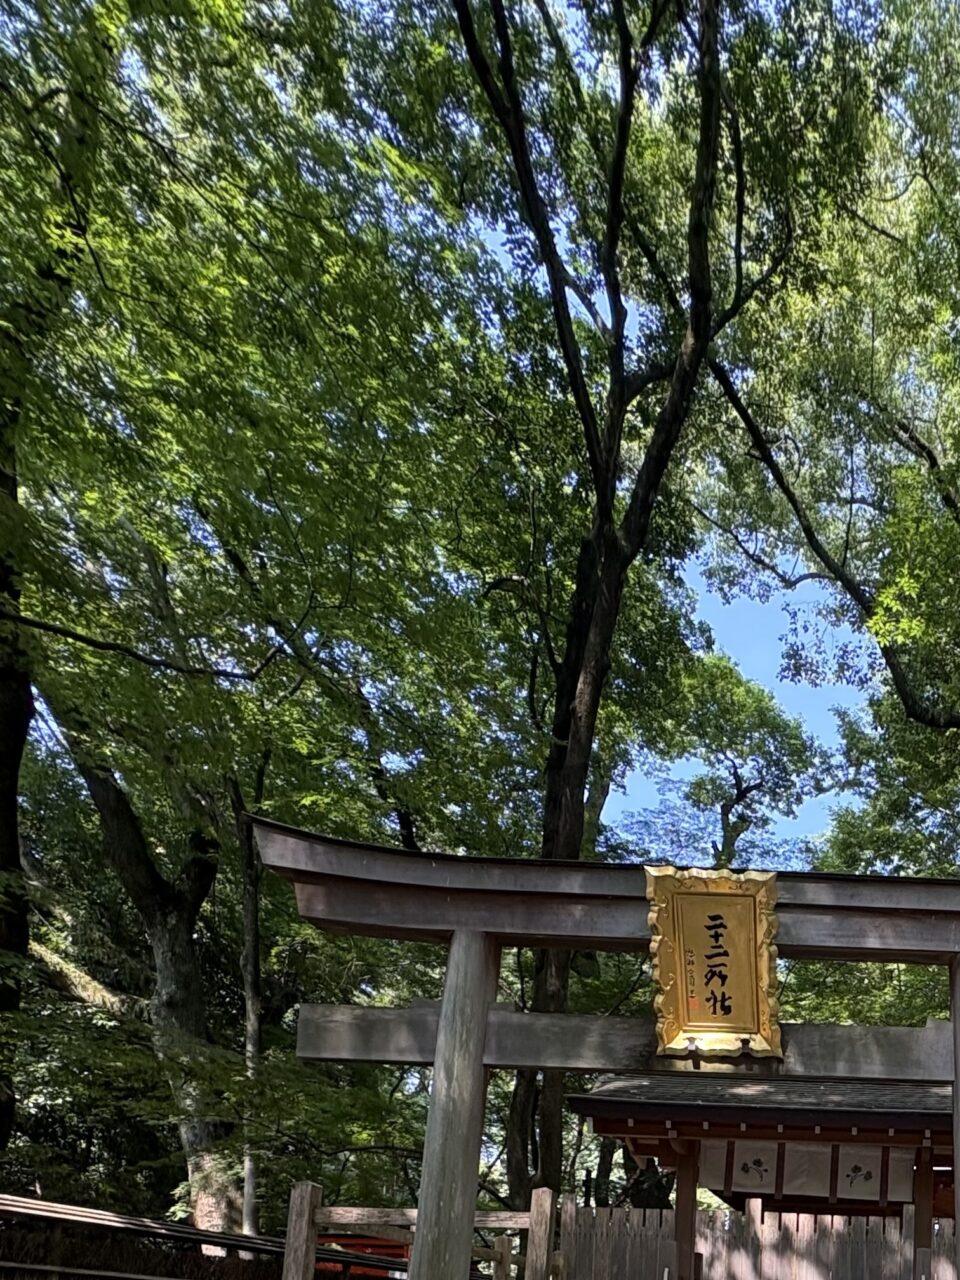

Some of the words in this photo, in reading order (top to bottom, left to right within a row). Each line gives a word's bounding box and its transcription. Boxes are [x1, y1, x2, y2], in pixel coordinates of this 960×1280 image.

[704, 914, 733, 1016] 二十二所社
